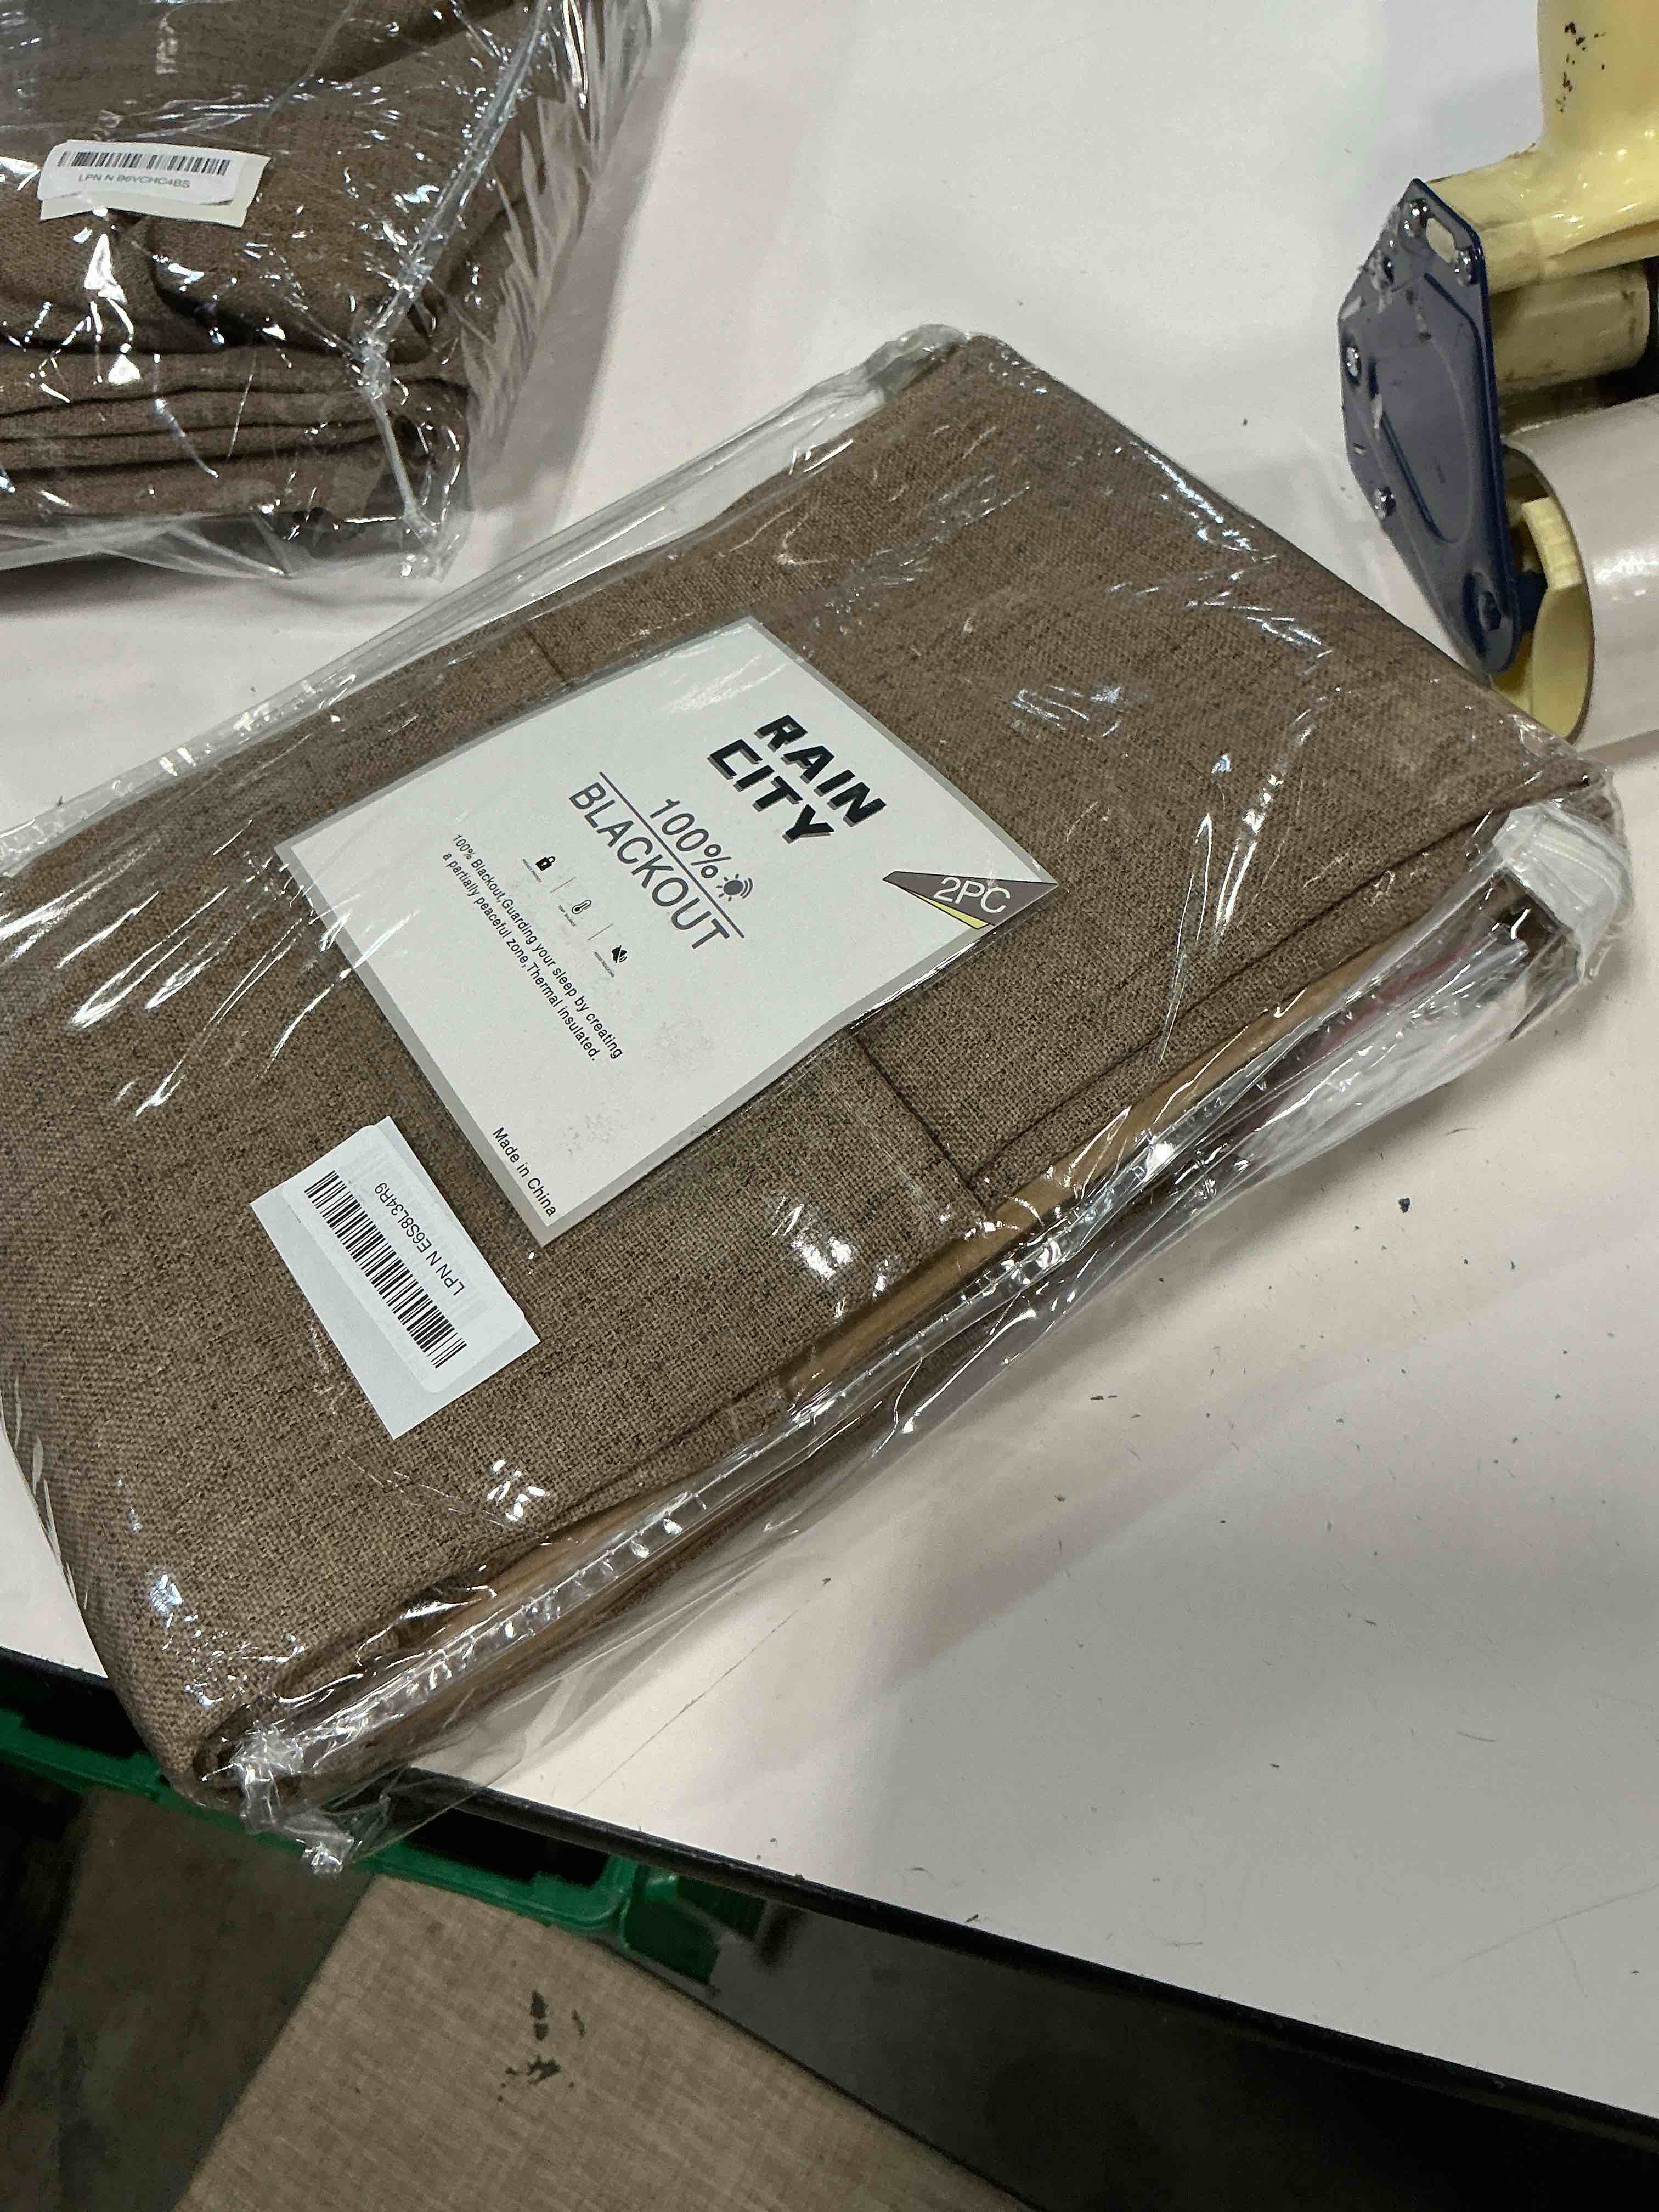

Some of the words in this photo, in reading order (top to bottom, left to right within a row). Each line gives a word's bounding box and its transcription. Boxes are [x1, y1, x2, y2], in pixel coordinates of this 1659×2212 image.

[707, 738, 834, 844] CITY
[754, 715, 887, 827] RAIN
[443, 853, 452, 861] a
[569, 782, 730, 949] BLACKOUT
[650, 798, 732, 879] 100%
[447, 861, 479, 896] partially
[933, 877, 1011, 913] 2PC
[453, 835, 474, 859] 100%
[532, 944, 556, 967] your
[553, 968, 577, 996] sleep
[574, 996, 589, 1012] by
[586, 1014, 622, 1059] creating
[474, 897, 512, 938] peaceful
[558, 1006, 600, 1060] insulated.
[493, 1127, 519, 1162] Made
[517, 1163, 529, 1177] in
[528, 1178, 555, 1217] China
[375, 1183, 432, 1253] E6S8L34R9
[426, 1251, 442, 1266] N
[436, 1264, 464, 1295] LPN
